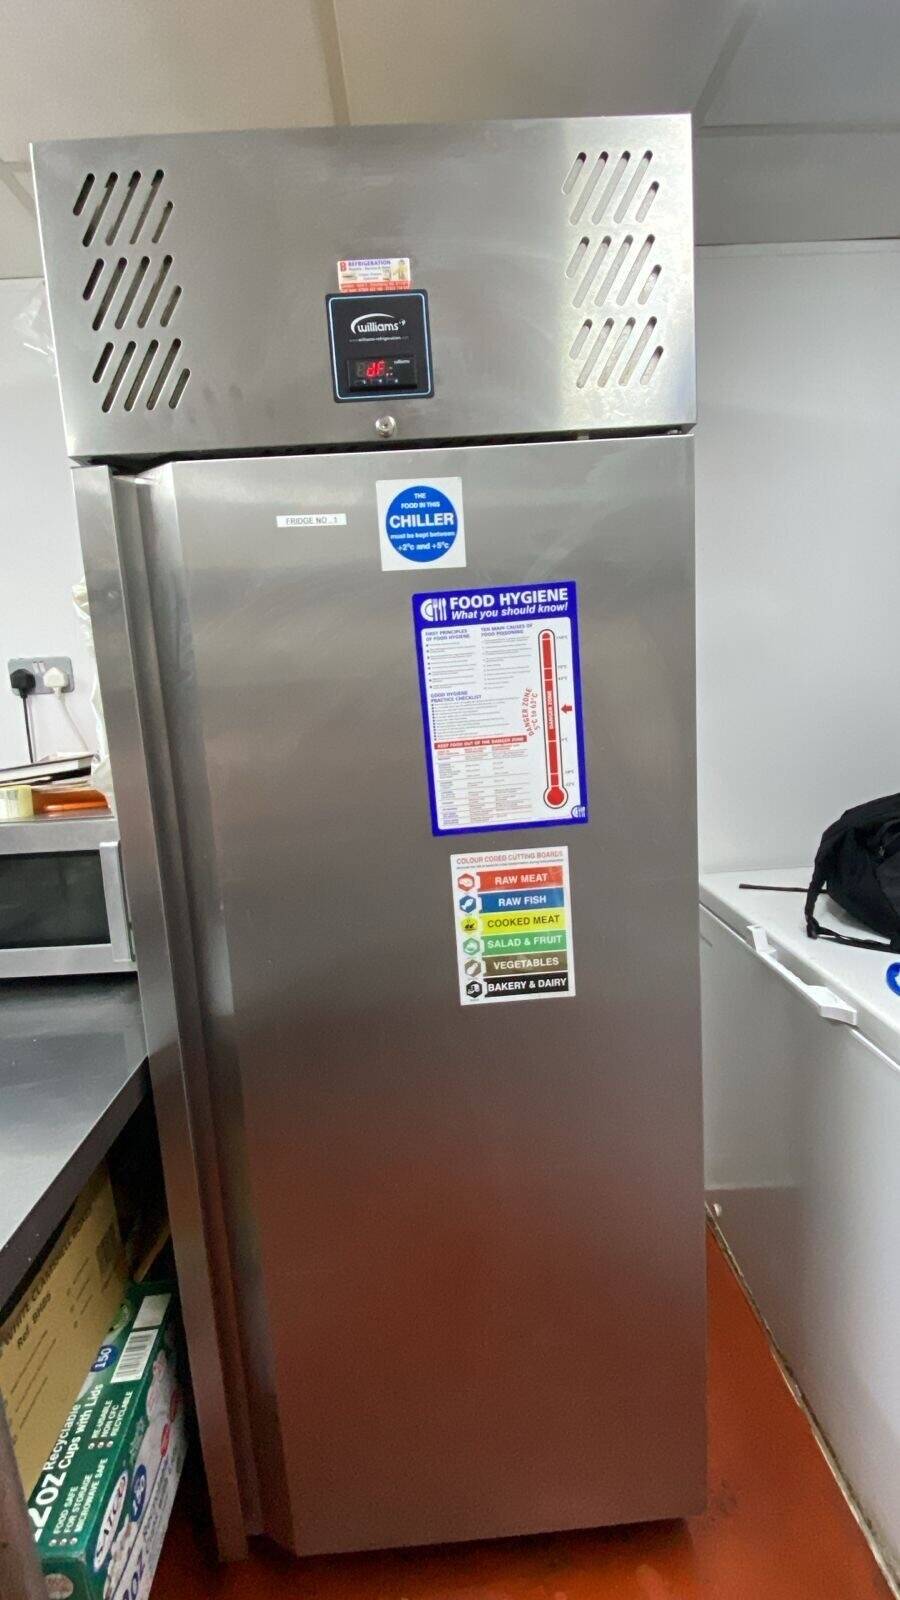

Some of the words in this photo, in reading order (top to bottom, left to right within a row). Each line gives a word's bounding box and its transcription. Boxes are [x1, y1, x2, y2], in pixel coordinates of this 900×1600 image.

[357, 322, 398, 332] williams
[414, 492, 426, 500] THE
[400, 502, 418, 510] FOOD
[286, 516, 314, 526] FRIDGE
[389, 512, 455, 529] CHILLER
[415, 532, 429, 540] kept
[430, 530, 456, 538] between
[416, 542, 430, 550] and
[450, 594, 495, 611] FOOD
[499, 588, 568, 607] HYGIENE
[452, 610, 478, 620] What
[479, 609, 500, 620] you
[500, 604, 536, 616] should
[538, 602, 568, 614] know!
[522, 688, 532, 706] ZONE
[522, 709, 535, 737] DANGER
[456, 856, 484, 864] COLOUR
[509, 852, 536, 861] CUTTING
[537, 851, 563, 859] BOARDS
[495, 876, 518, 885] RAW
[520, 873, 548, 883] MEAT
[498, 898, 522, 907] RAW
[524, 895, 546, 905] FISH
[488, 917, 530, 928] COOKED
[533, 915, 560, 925] MEAT
[487, 939, 521, 949] SALAD
[525, 938, 531, 946] &
[534, 936, 562, 945] FRUIT
[493, 958, 559, 970] VEGETABLES
[488, 982, 526, 992] BAKERY
[529, 981, 536, 989] &
[538, 978, 567, 988] DAIRY
[94, 1346, 113, 1370] 150
[101, 1420, 113, 1438] NON
[108, 1404, 120, 1420] CFC
[110, 1390, 134, 1437] RECYCLABLE
[58, 1436, 81, 1469] Cups
[75, 1409, 93, 1434] with
[84, 1384, 104, 1407] Lids
[42, 1404, 82, 1471] Recyclable
[74, 1480, 100, 1532] MICROWAVE
[95, 1457, 109, 1480] SAFE
[53, 1508, 69, 1534] FOOD
[64, 1486, 79, 1508] SAFE
[63, 1514, 77, 1534] FOR
[72, 1474, 93, 1513] STORAGE
